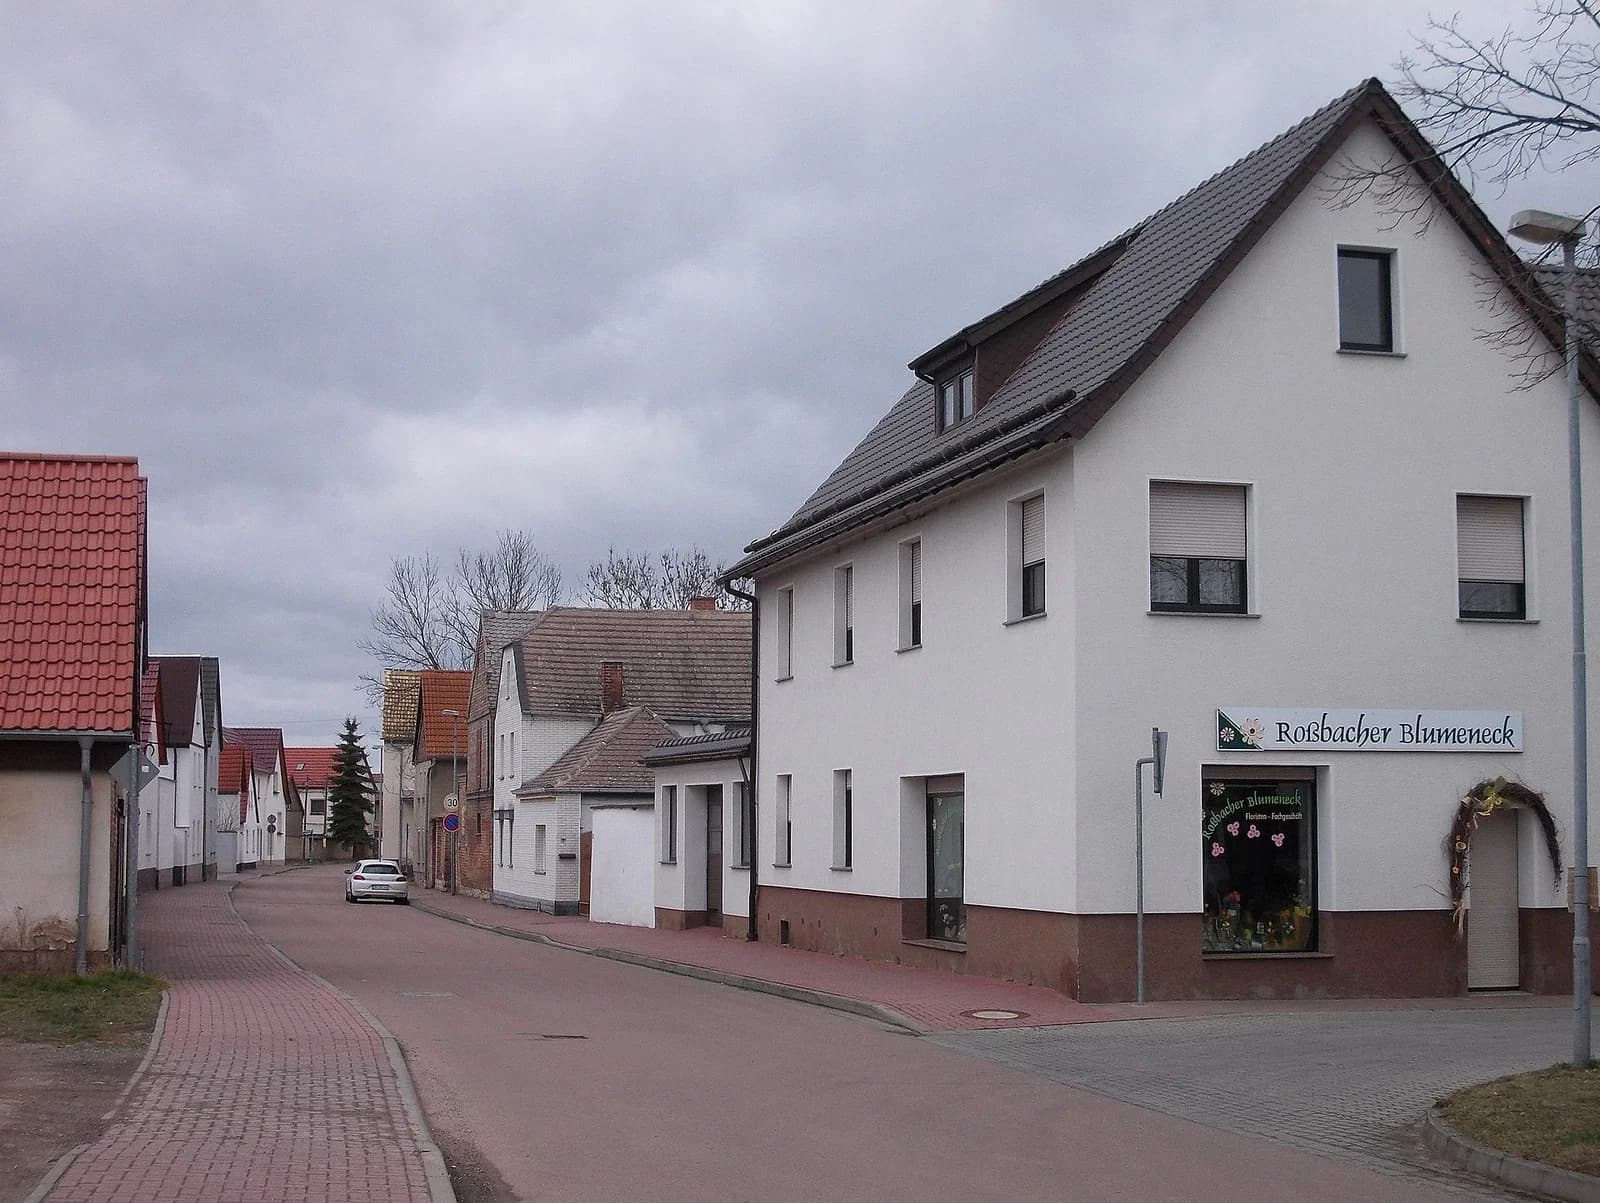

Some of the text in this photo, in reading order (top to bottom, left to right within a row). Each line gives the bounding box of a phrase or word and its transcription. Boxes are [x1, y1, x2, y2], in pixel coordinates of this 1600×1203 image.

[1276, 712, 1515, 747] Roßbacher Blumeneck
[447, 798, 458, 807] 30
[1203, 789, 1302, 840] Roßbacher Blumeneck
